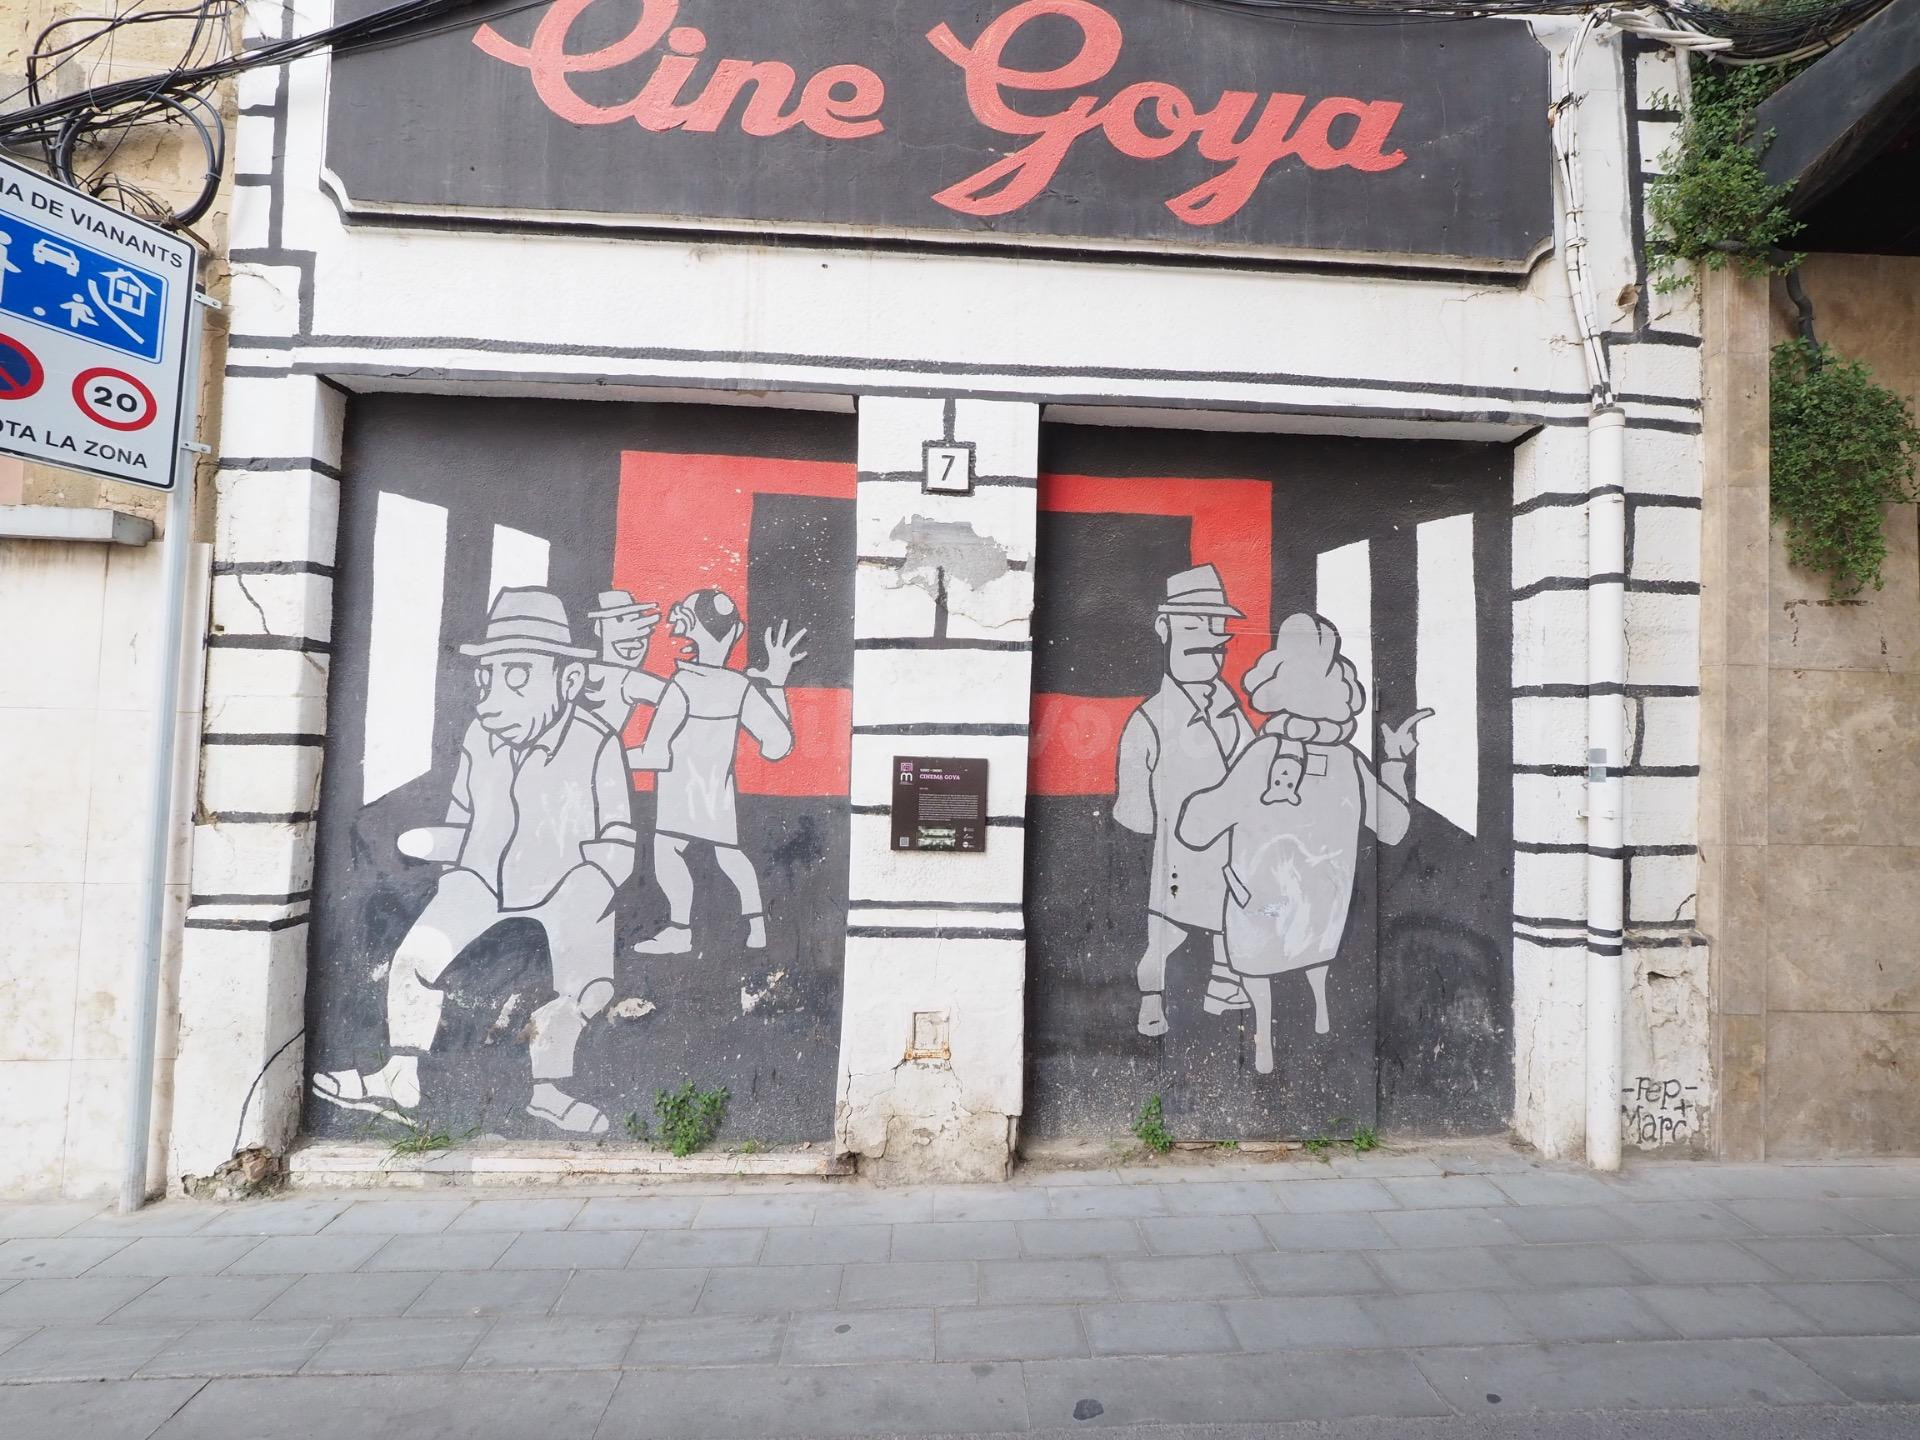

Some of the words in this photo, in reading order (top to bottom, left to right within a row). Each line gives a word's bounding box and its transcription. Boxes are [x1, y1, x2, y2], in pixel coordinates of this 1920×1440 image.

[472, 0, 885, 138] Cine
[925, 0, 1408, 225] Goya
[31, 190, 64, 219] DE
[71, 207, 183, 269] VIANANTS
[94, 386, 137, 413] 20
[0, 419, 37, 442] TA
[45, 430, 77, 452] LA
[84, 440, 148, 469] ZONA
[941, 454, 956, 481] 7
[919, 773, 944, 781] CINEMA
[1621, 1104, 1687, 1145] Marc
